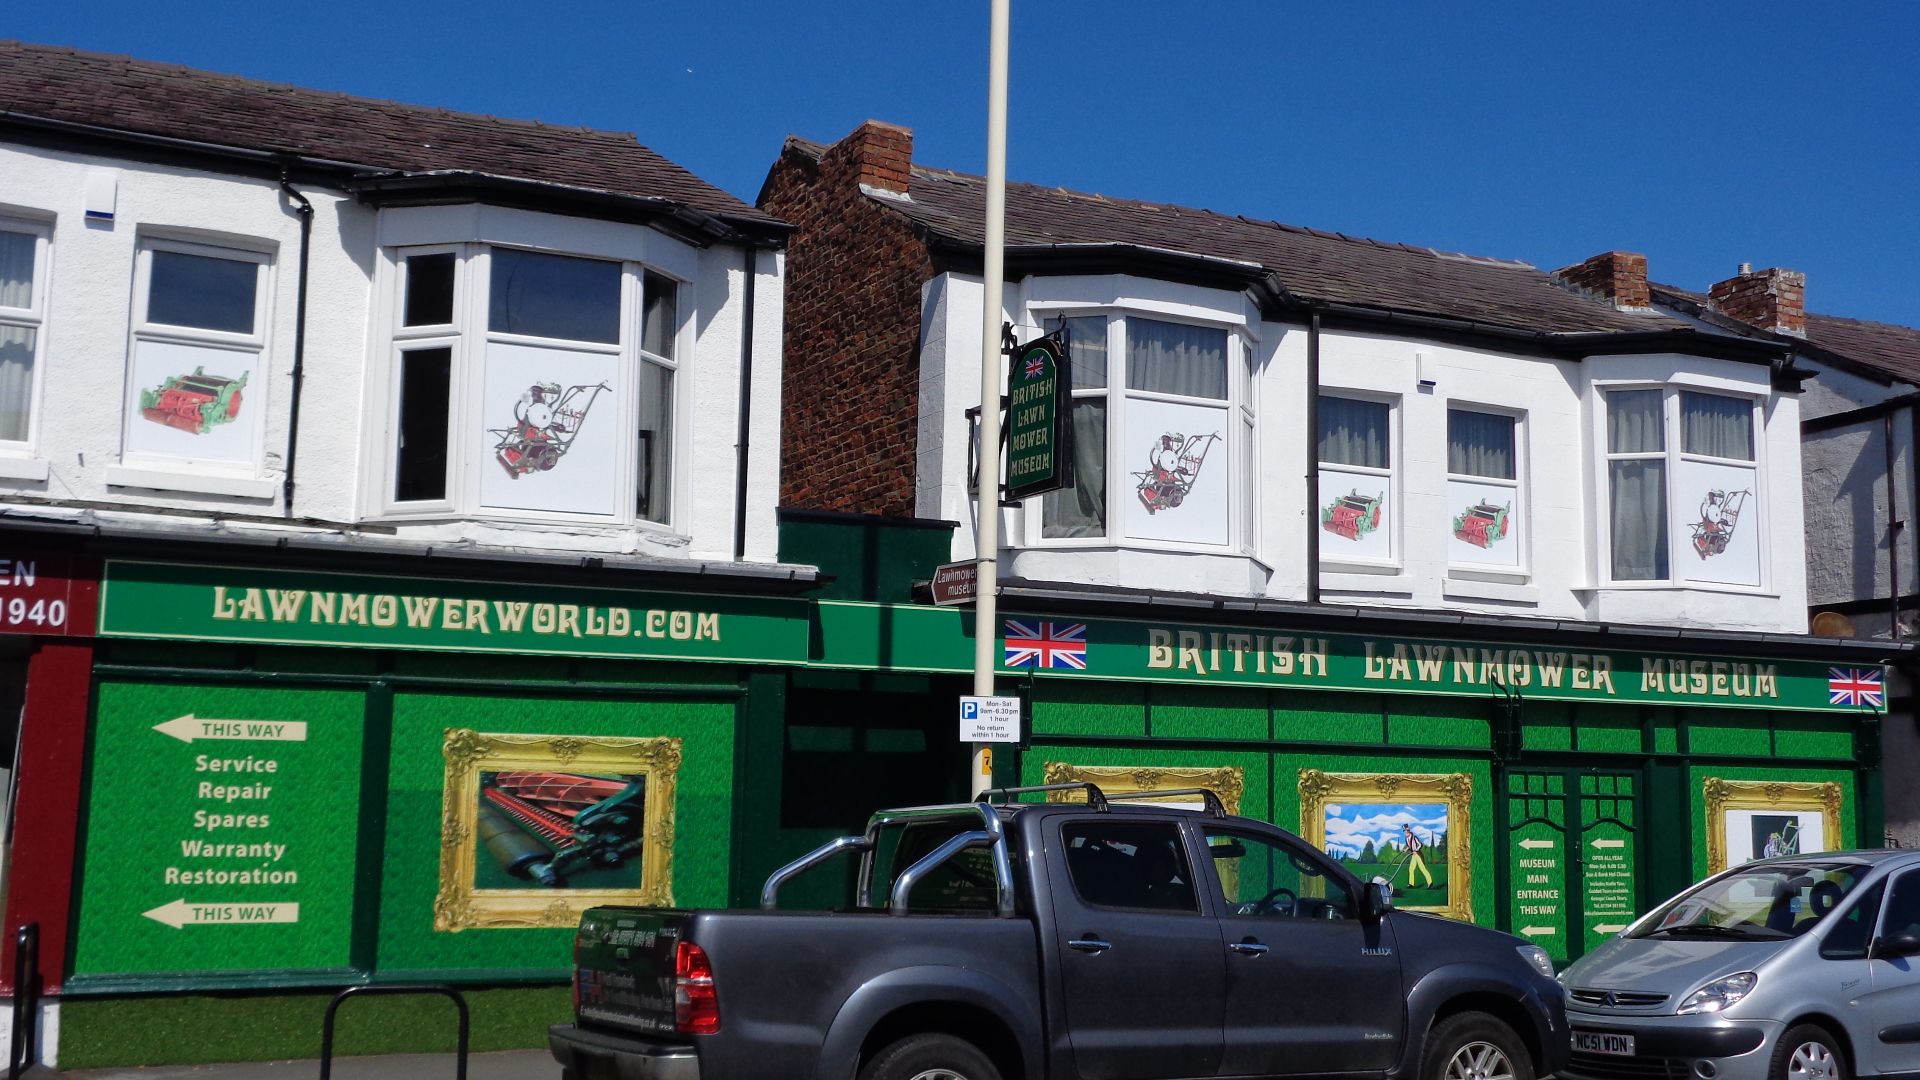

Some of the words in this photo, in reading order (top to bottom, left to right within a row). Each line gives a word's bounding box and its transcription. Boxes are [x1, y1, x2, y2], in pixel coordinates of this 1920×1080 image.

[1012, 377, 1053, 406] BRITISH
[1017, 403, 1046, 427] LAWN
[1012, 427, 1048, 452] MOWER
[1010, 452, 1050, 478] MUSEUM
[0, 559, 36, 587] EN
[212, 585, 720, 642] LAWNMOWERWORLD.COM
[1147, 628, 1329, 676] BRITISH
[1363, 641, 1616, 695] LAWNMOWER
[1640, 656, 1778, 699] MUSEUM
[964, 702, 976, 719] P
[202, 723, 242, 737] THIS
[247, 724, 285, 738] WAY
[195, 754, 278, 773] Service
[198, 781, 272, 803] Repair
[194, 809, 270, 832] Spares
[181, 839, 286, 862] Warranty
[164, 862, 298, 885] Restoration
[1519, 859, 1555, 868] MUSEUM
[1526, 874, 1549, 883] MAIN
[1517, 890, 1559, 899] ENTRANCE
[192, 907, 233, 921] THIS
[238, 906, 276, 920] WAY
[1520, 905, 1538, 915] THIS
[1539, 905, 1557, 915] WAY
[1361, 947, 1392, 956] HILUX
[1603, 1036, 1627, 1052] WDN
